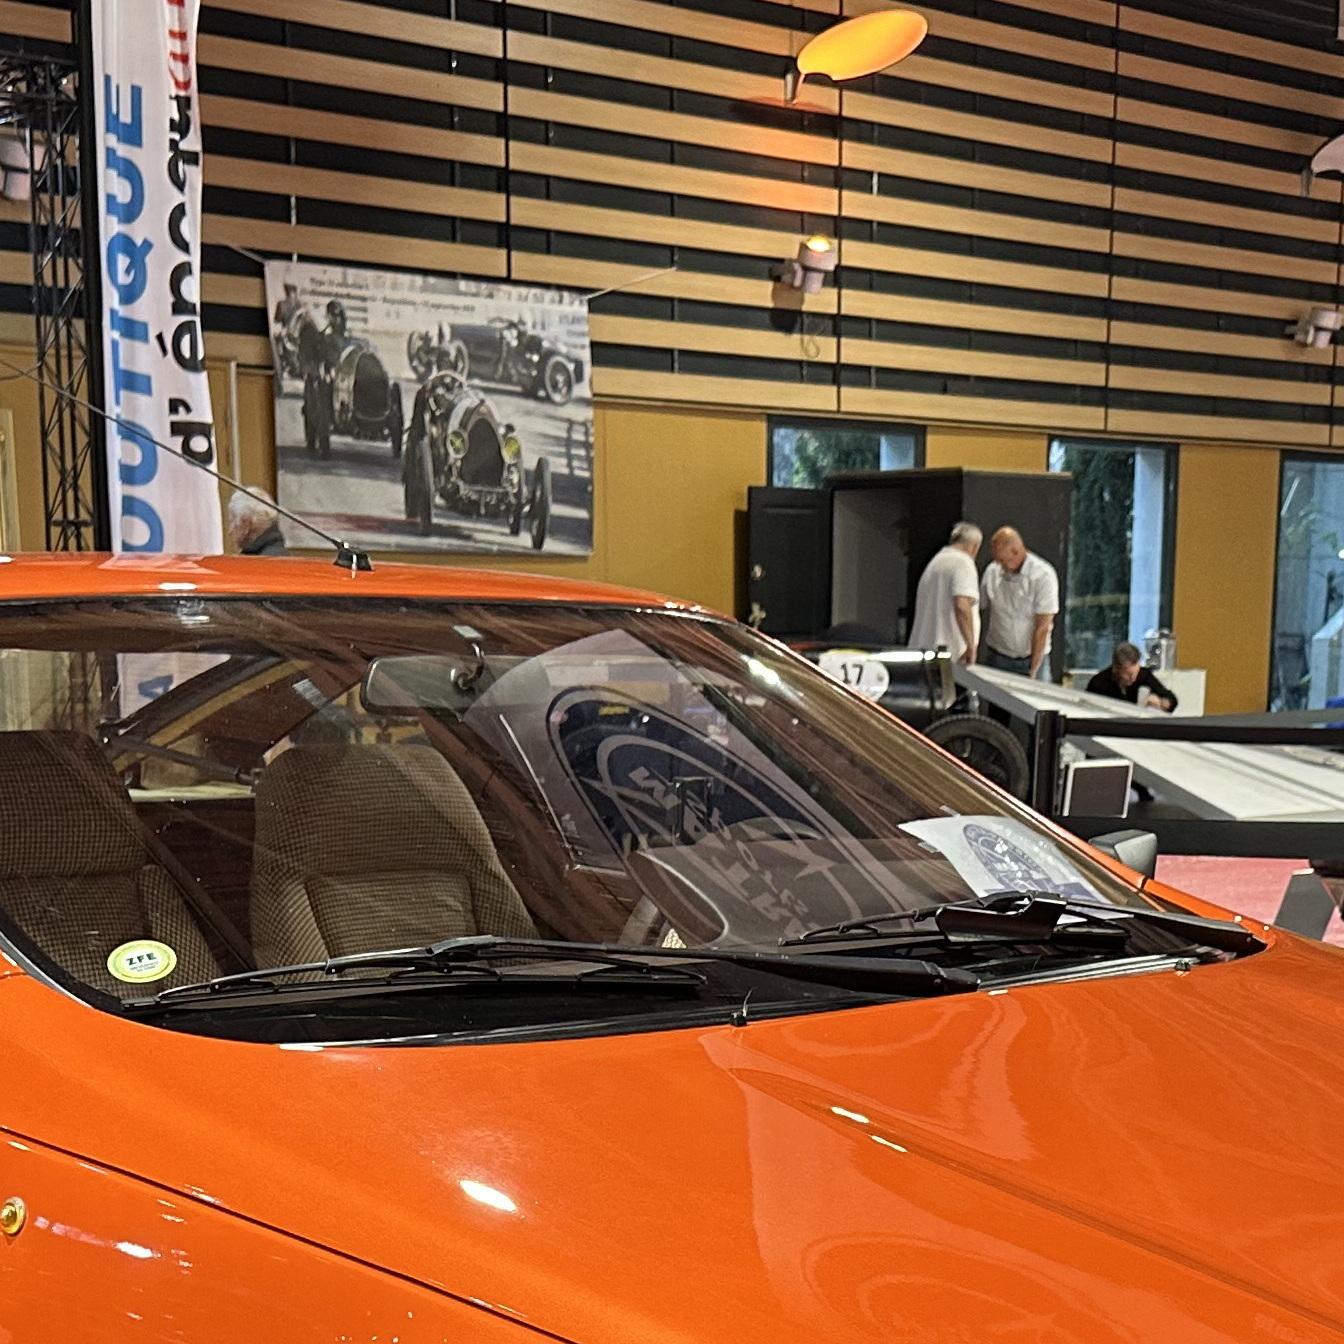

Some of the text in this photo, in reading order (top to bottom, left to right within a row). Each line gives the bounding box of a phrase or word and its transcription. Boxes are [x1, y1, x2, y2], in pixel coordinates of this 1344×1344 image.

[104, 74, 164, 554] OUTIQUE
[840, 662, 864, 685] 17
[126, 953, 157, 966] ZFE
